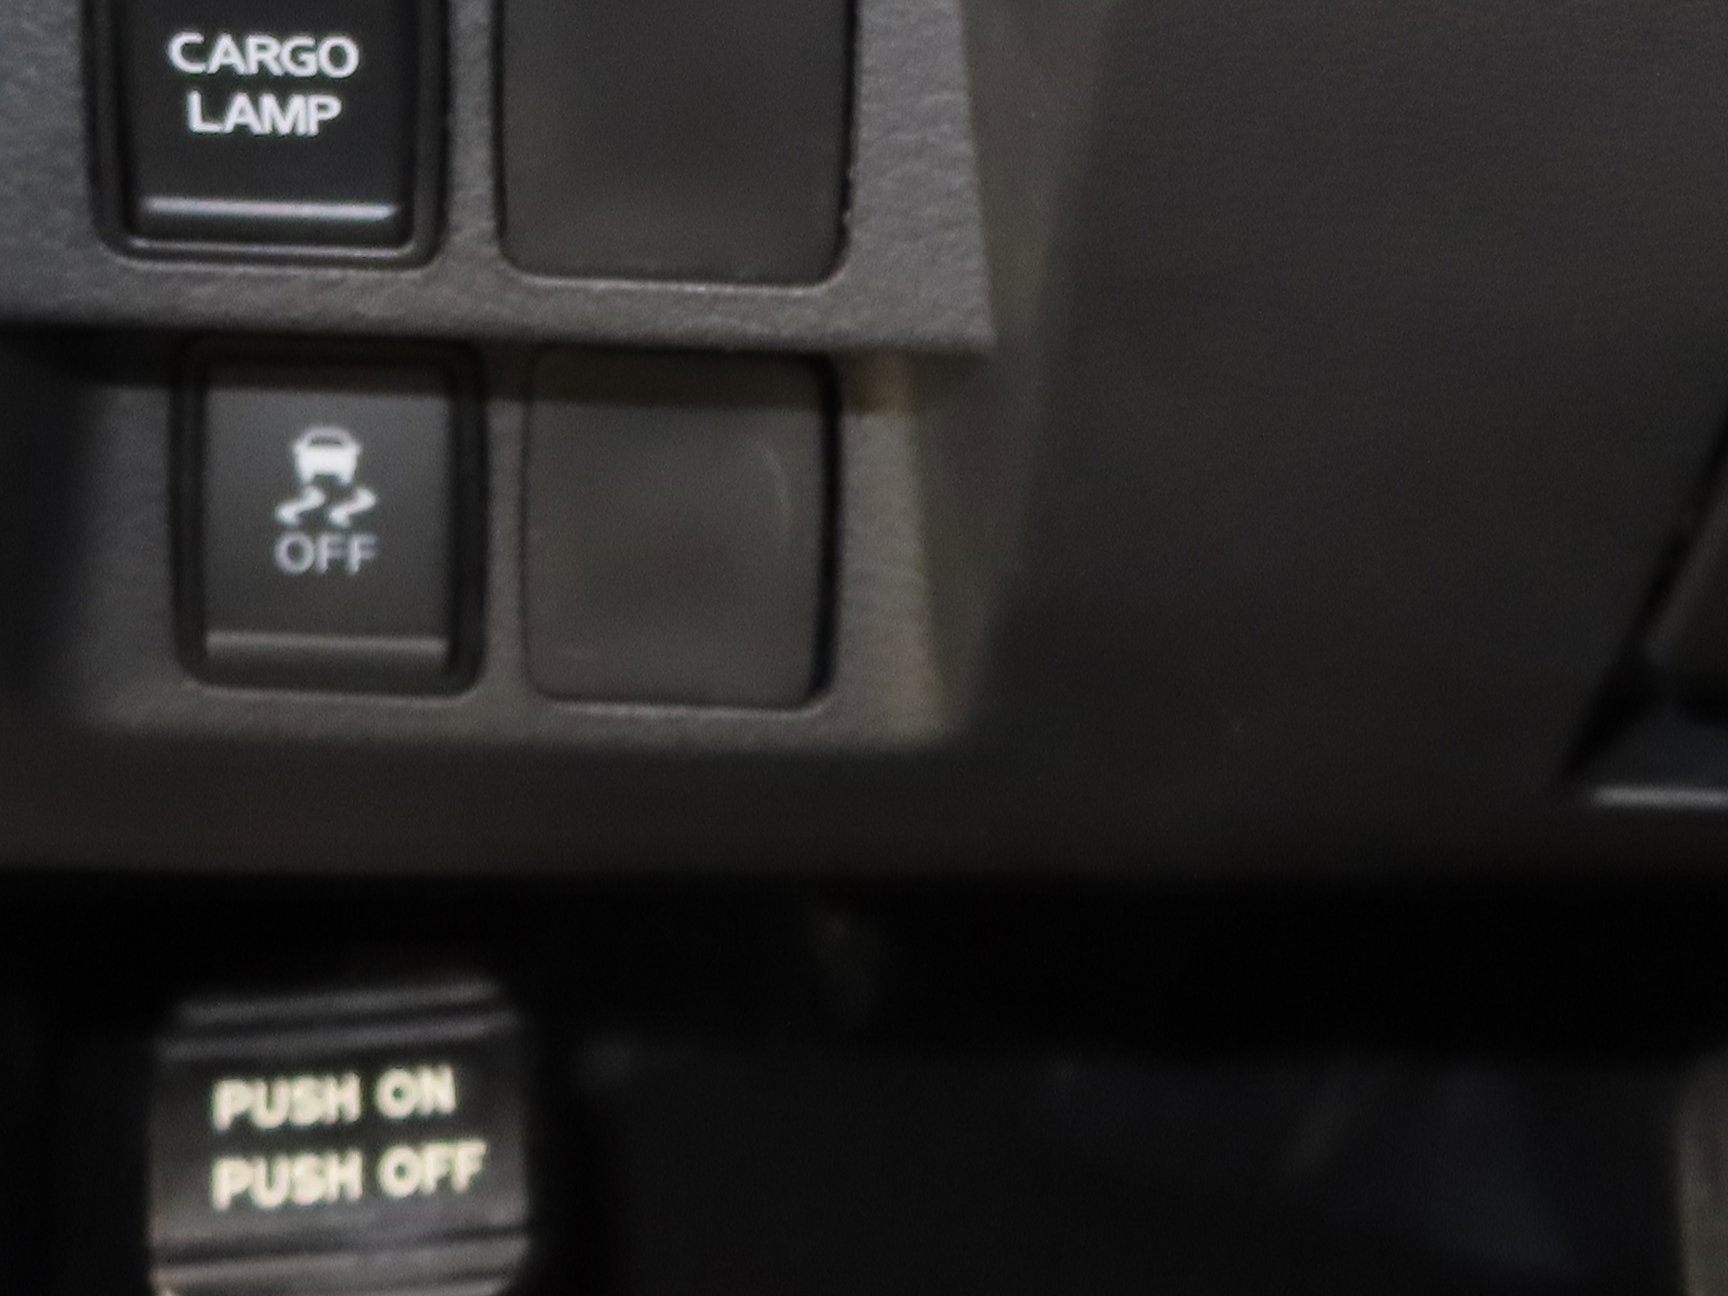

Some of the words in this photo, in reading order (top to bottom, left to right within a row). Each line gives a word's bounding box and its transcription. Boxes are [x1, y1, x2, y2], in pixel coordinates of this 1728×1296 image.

[167, 30, 360, 79] CARGO
[186, 89, 343, 137] LAMP
[274, 530, 378, 576] OFF
[211, 1072, 362, 1131] PUSH
[374, 1065, 458, 1120] ON
[211, 1150, 363, 1209] PUSH
[377, 1140, 488, 1198] OFF
